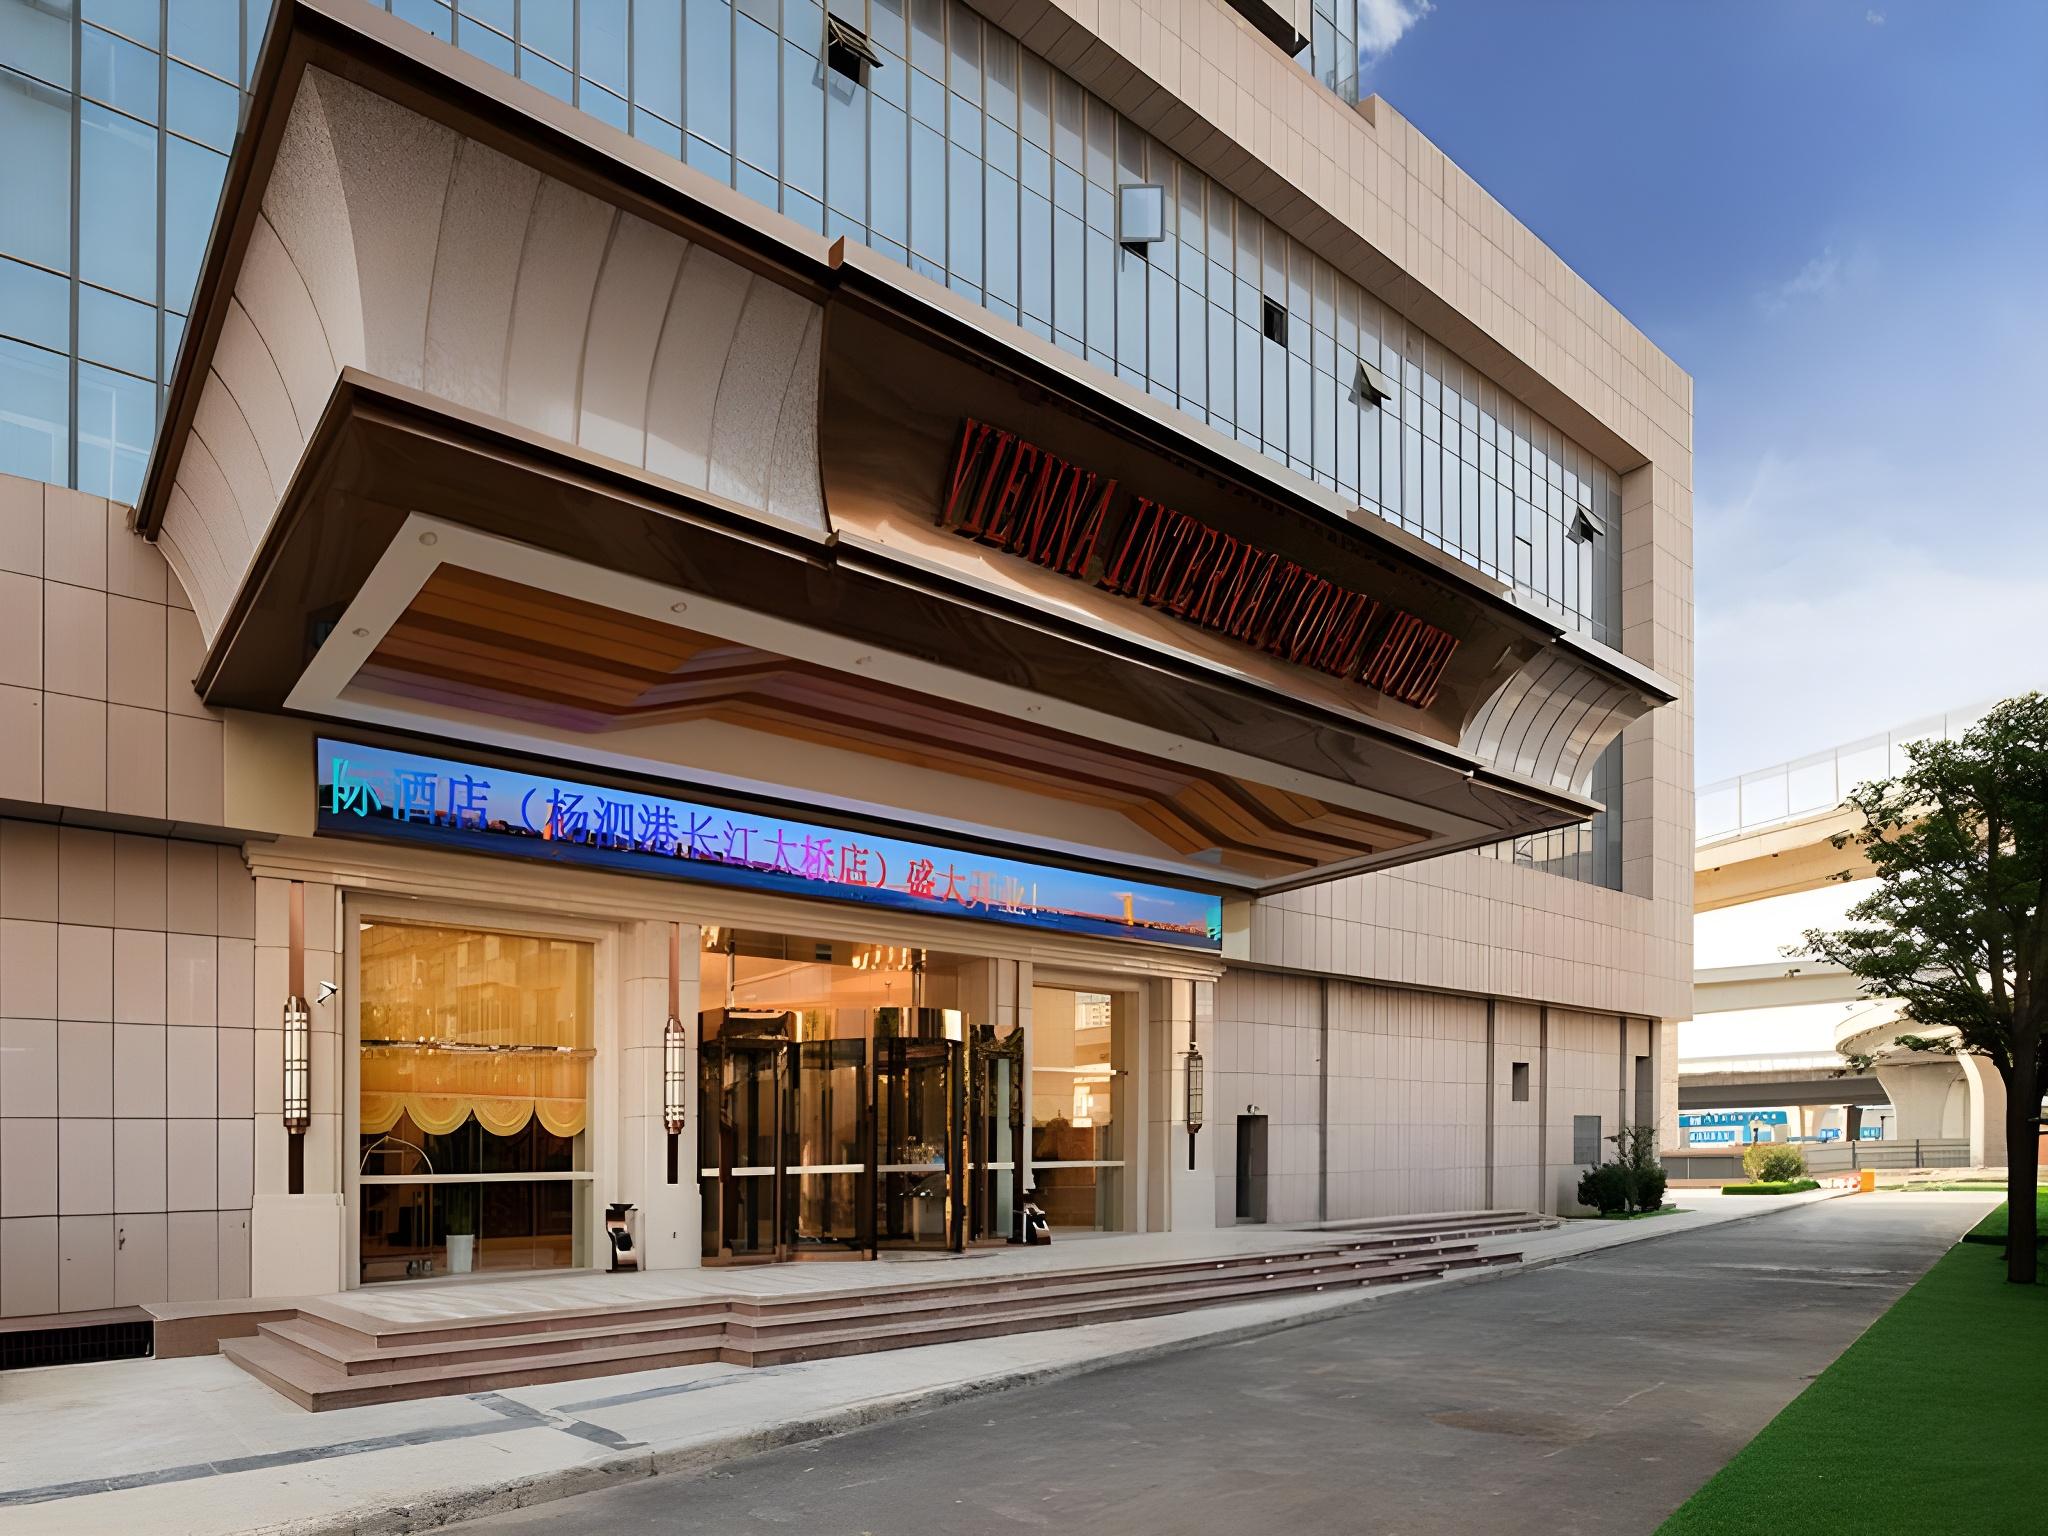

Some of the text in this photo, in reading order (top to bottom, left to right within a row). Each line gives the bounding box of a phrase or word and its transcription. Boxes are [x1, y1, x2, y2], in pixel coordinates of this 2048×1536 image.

[942, 417, 1462, 709] VIENNA INTERNATIONAL HOTEL
